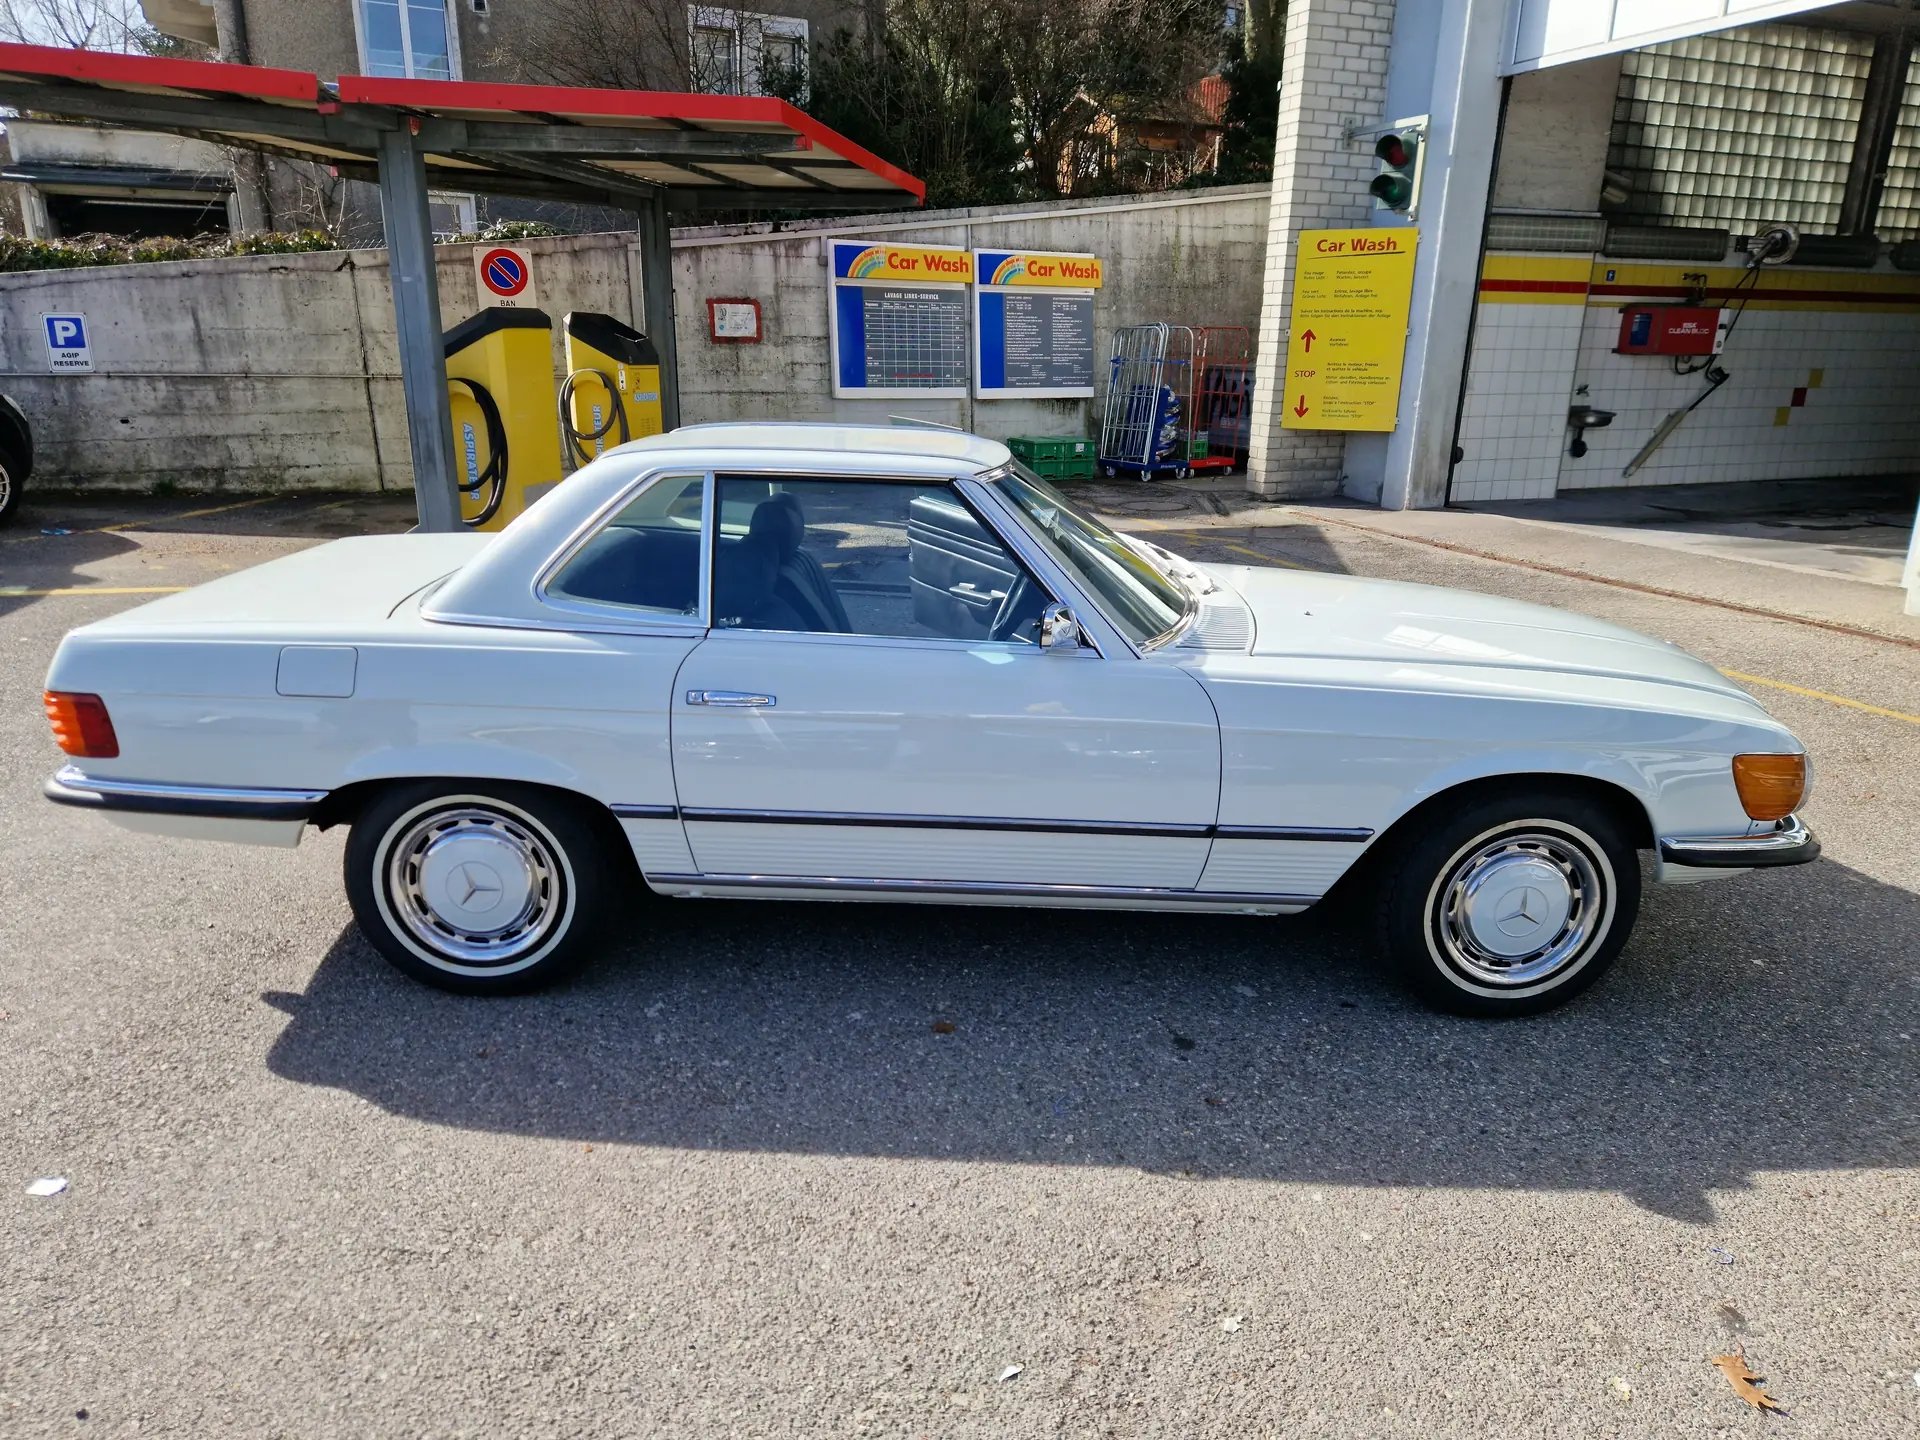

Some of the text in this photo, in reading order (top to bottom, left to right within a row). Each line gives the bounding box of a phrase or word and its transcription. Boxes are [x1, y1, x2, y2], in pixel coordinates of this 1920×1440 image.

[1317, 237, 1397, 252] Car Wash
[888, 252, 918, 270] Car
[924, 254, 968, 272] Wash
[1028, 260, 1055, 276] Car
[1060, 262, 1099, 279] Wash
[54, 320, 76, 345] P
